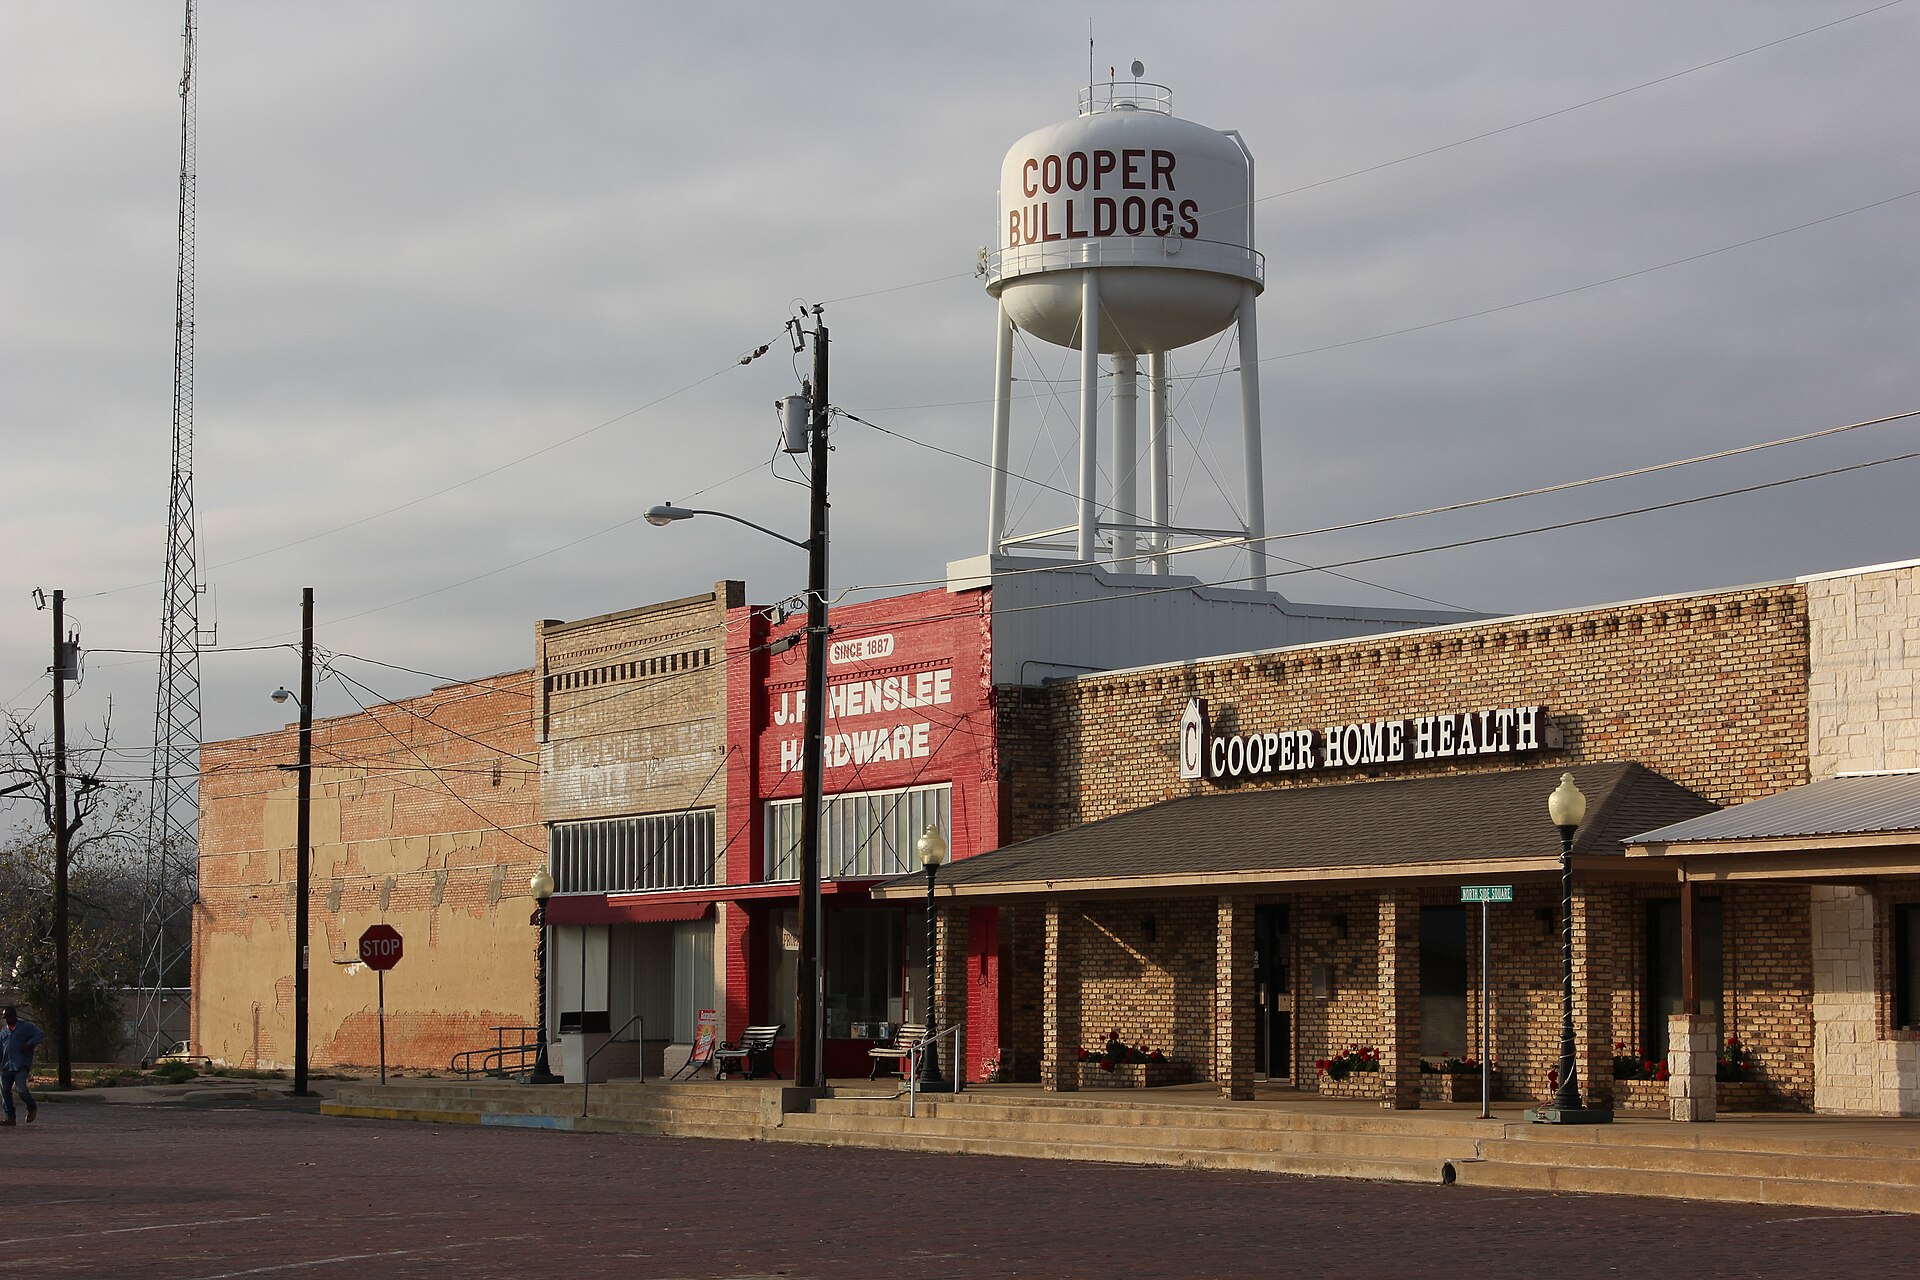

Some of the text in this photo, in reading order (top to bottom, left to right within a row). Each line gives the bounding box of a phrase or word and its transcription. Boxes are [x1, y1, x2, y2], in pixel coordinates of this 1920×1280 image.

[1022, 149, 1176, 198] COOPER
[1009, 195, 1199, 249] BULLDOGS
[834, 637, 890, 661] SINCE 1887
[828, 668, 952, 719] HENSLEE
[780, 722, 930, 773] HRDWARE
[1184, 706, 1539, 778] C COOPER HOME HEALTH
[1462, 887, 1511, 900] NORTH SIDE SQUARE
[362, 938, 400, 957] STOP
